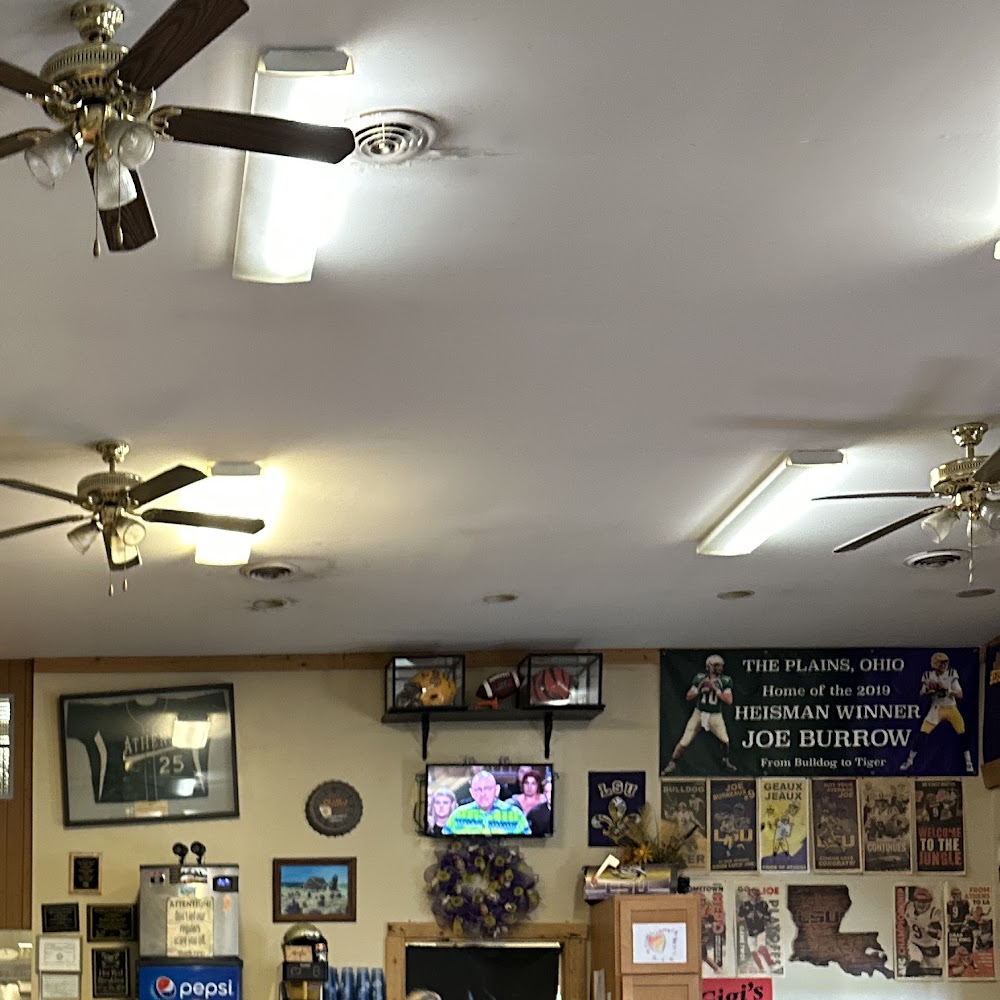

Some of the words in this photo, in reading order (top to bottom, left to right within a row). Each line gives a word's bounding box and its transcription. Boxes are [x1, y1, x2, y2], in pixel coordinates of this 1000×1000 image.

[742, 658, 781, 672] THE
[785, 658, 855, 674] PLAINS,
[860, 658, 905, 672] OHIO
[762, 685, 805, 697] Home
[809, 685, 825, 697] of
[830, 685, 852, 697] the
[856, 685, 891, 697] 2019
[735, 705, 829, 721] HEISMAN
[836, 704, 921, 720] WINNER
[124, 735, 174, 754] ATHEN
[742, 730, 791, 748] JOE
[799, 729, 912, 748] BURROW
[159, 755, 185, 775] 25
[761, 758, 791, 768] From
[794, 757, 838, 769] Bulldog
[841, 758, 852, 768] to
[855, 757, 888, 770] Tiger
[598, 780, 639, 798] LSU
[663, 785, 705, 794] BULLDOG
[725, 782, 744, 792] JOE
[763, 782, 803, 791] GEAUX
[765, 792, 802, 800] JEAUX
[713, 828, 753, 843] LU
[918, 827, 962, 838] WELCOME
[816, 835, 855, 848] LU
[867, 843, 907, 852] CONTINUES
[920, 838, 934, 850] TO
[938, 838, 960, 850] THE
[919, 851, 962, 865] JUNGLE
[762, 886, 780, 895] JOE
[796, 911, 841, 924] LSU
[952, 906, 959, 918] 9
[180, 979, 234, 1000] pepsi
